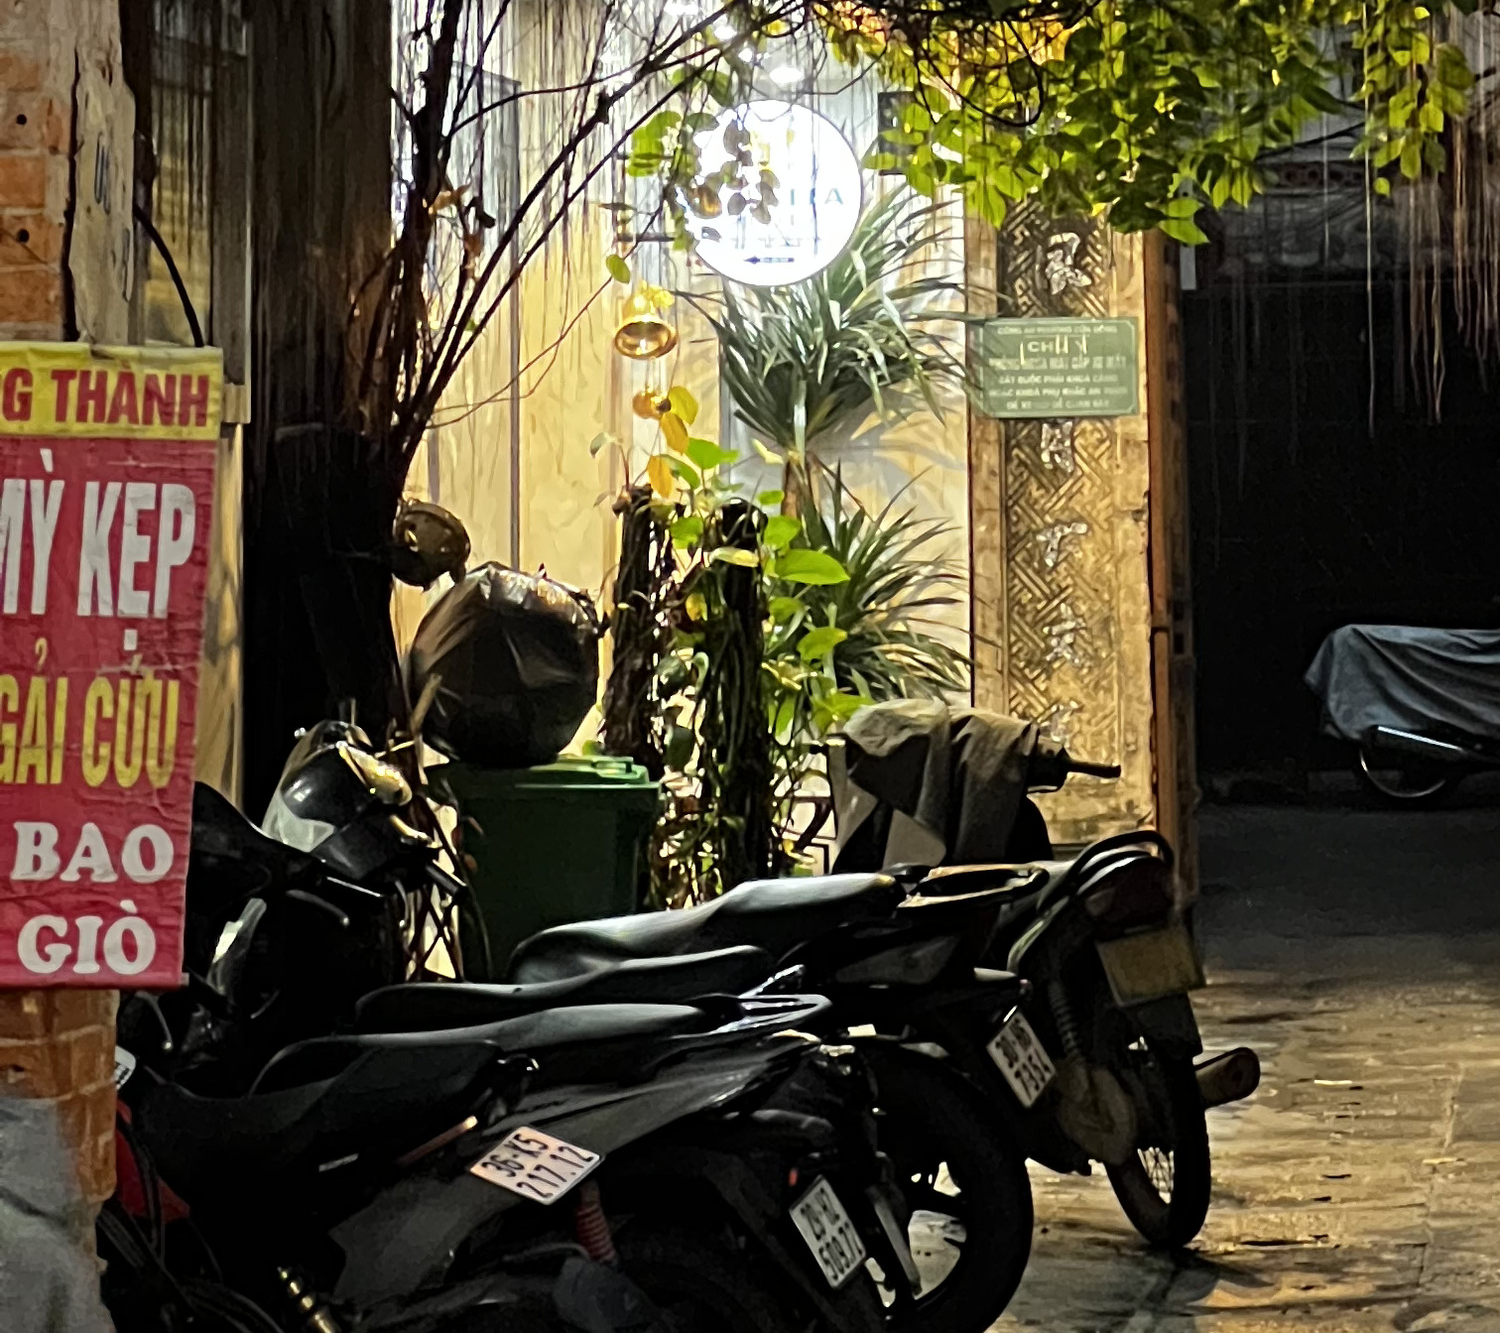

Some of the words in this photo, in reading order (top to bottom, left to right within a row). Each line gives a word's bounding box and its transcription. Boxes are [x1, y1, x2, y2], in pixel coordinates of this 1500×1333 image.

[77, 481, 196, 651] KẸP
[82, 654, 180, 788] CỨU
[10, 821, 174, 884] BAO
[18, 899, 156, 975] GIÒ
[516, 1146, 595, 1198] 217.12
